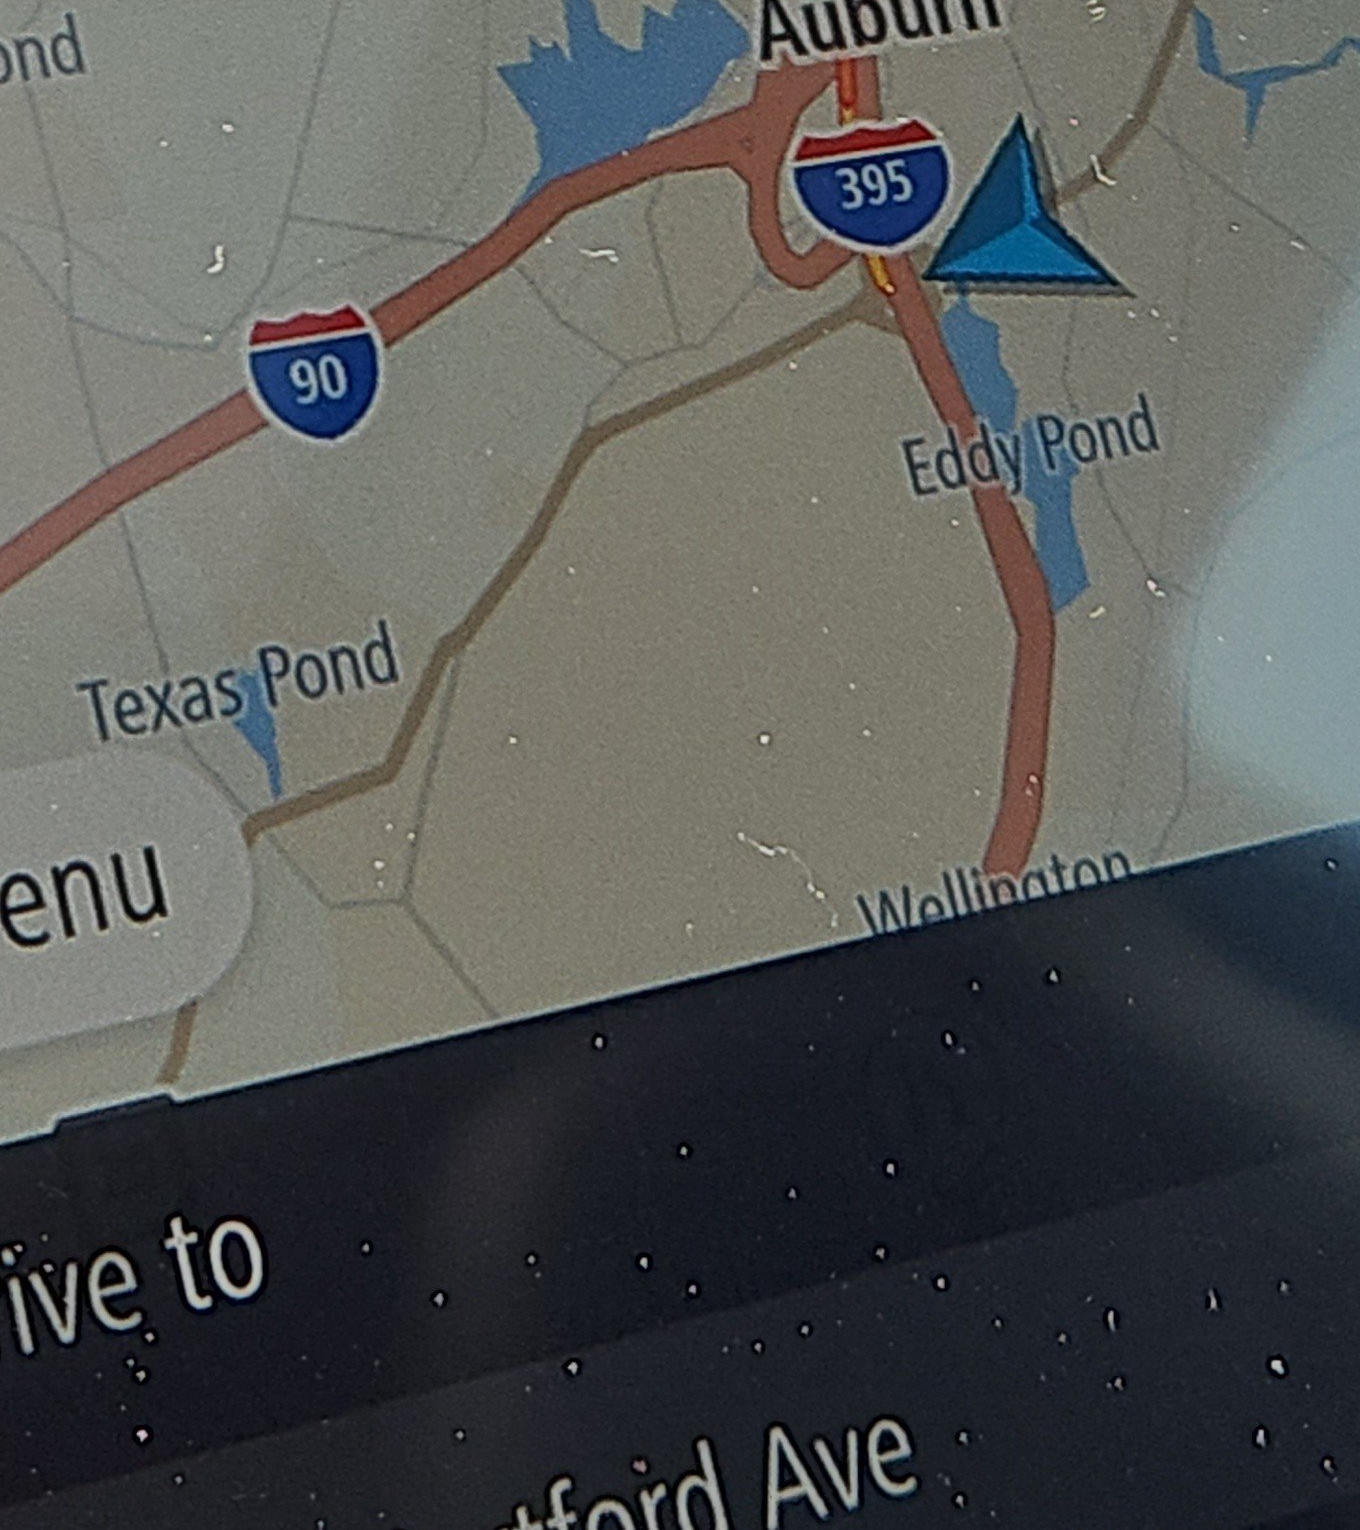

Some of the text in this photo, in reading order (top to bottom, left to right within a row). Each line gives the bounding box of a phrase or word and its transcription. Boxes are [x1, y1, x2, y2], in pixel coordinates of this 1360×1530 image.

[839, 159, 914, 211] 395
[287, 353, 349, 406] 90
[901, 392, 1161, 498] Eddy Pond
[76, 619, 402, 744] Texas Pond
[163, 1213, 264, 1312] to
[767, 1418, 920, 1530] Ave
